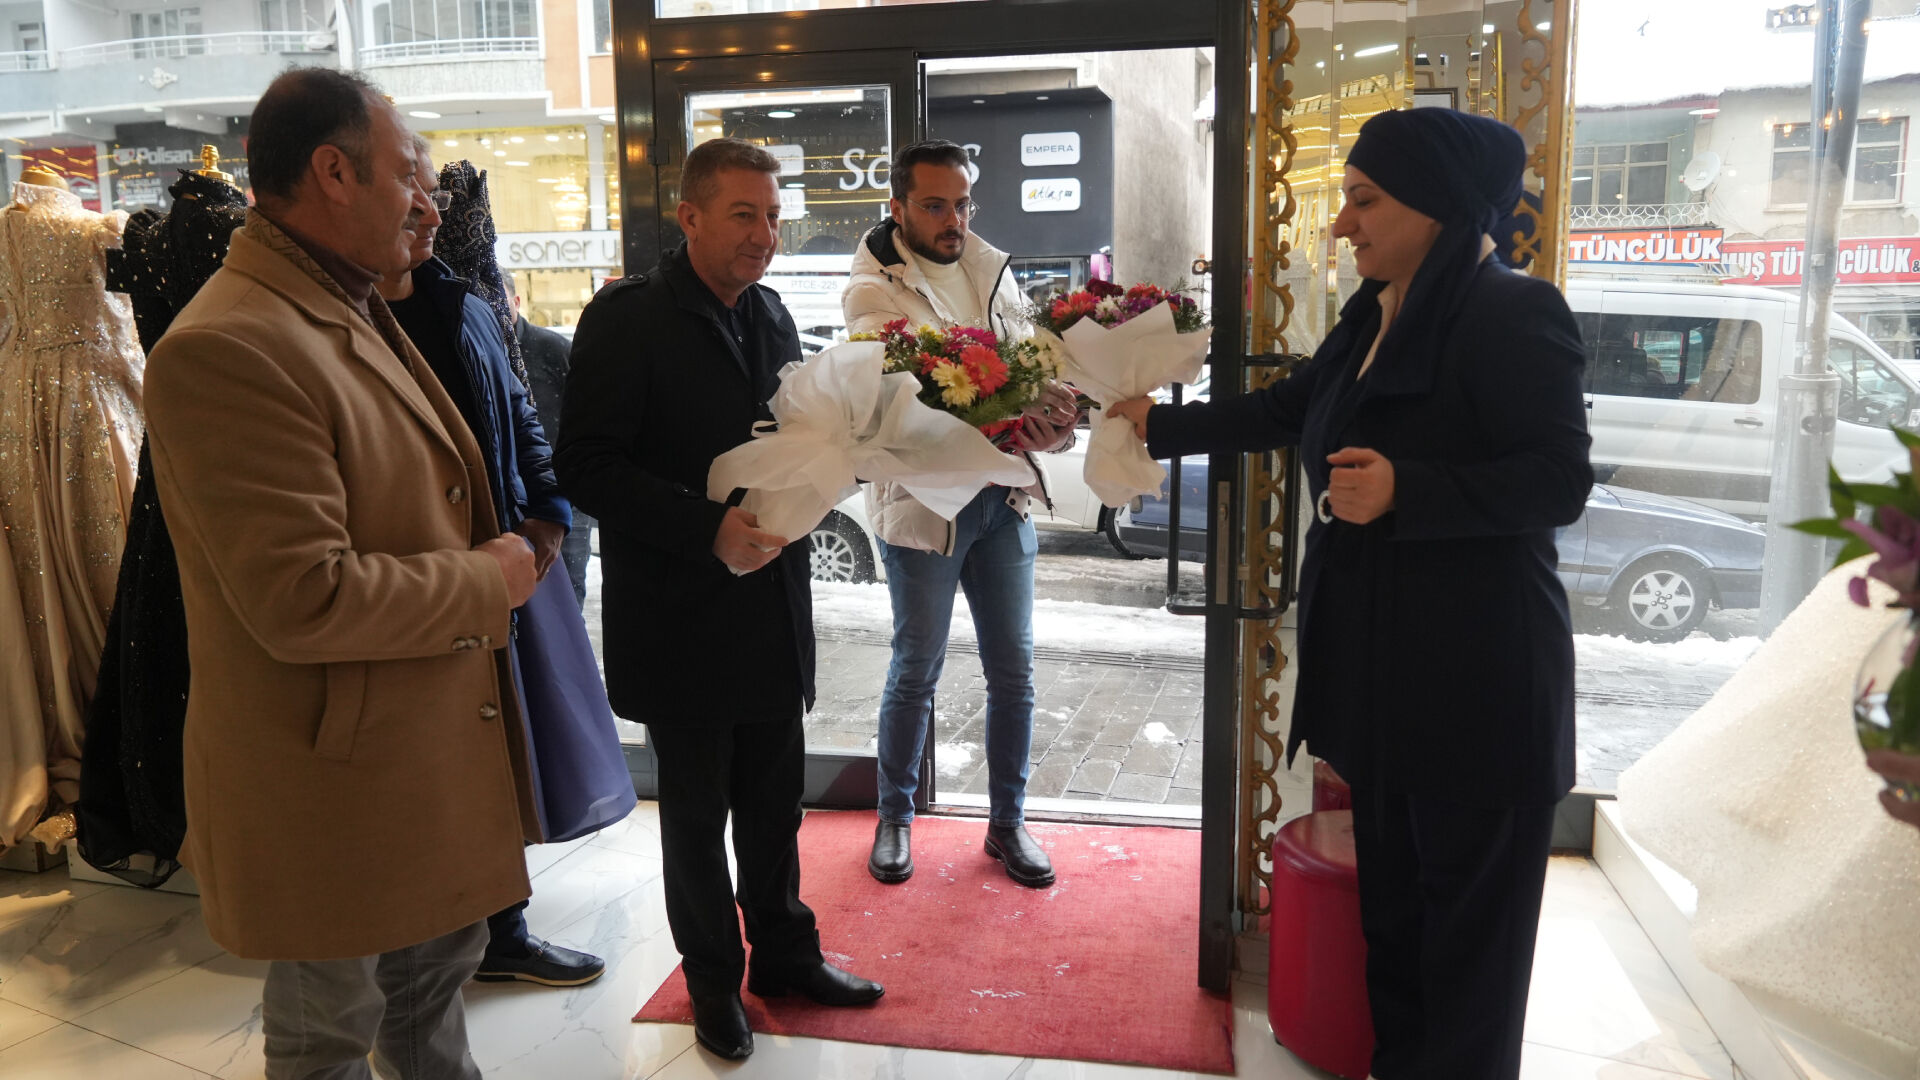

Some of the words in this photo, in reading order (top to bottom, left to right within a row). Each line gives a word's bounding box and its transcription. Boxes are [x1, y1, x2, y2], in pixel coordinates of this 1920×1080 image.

[136, 146, 193, 165] Polisan
[1026, 144, 1074, 154] EMPERA
[509, 239, 592, 263] soner
